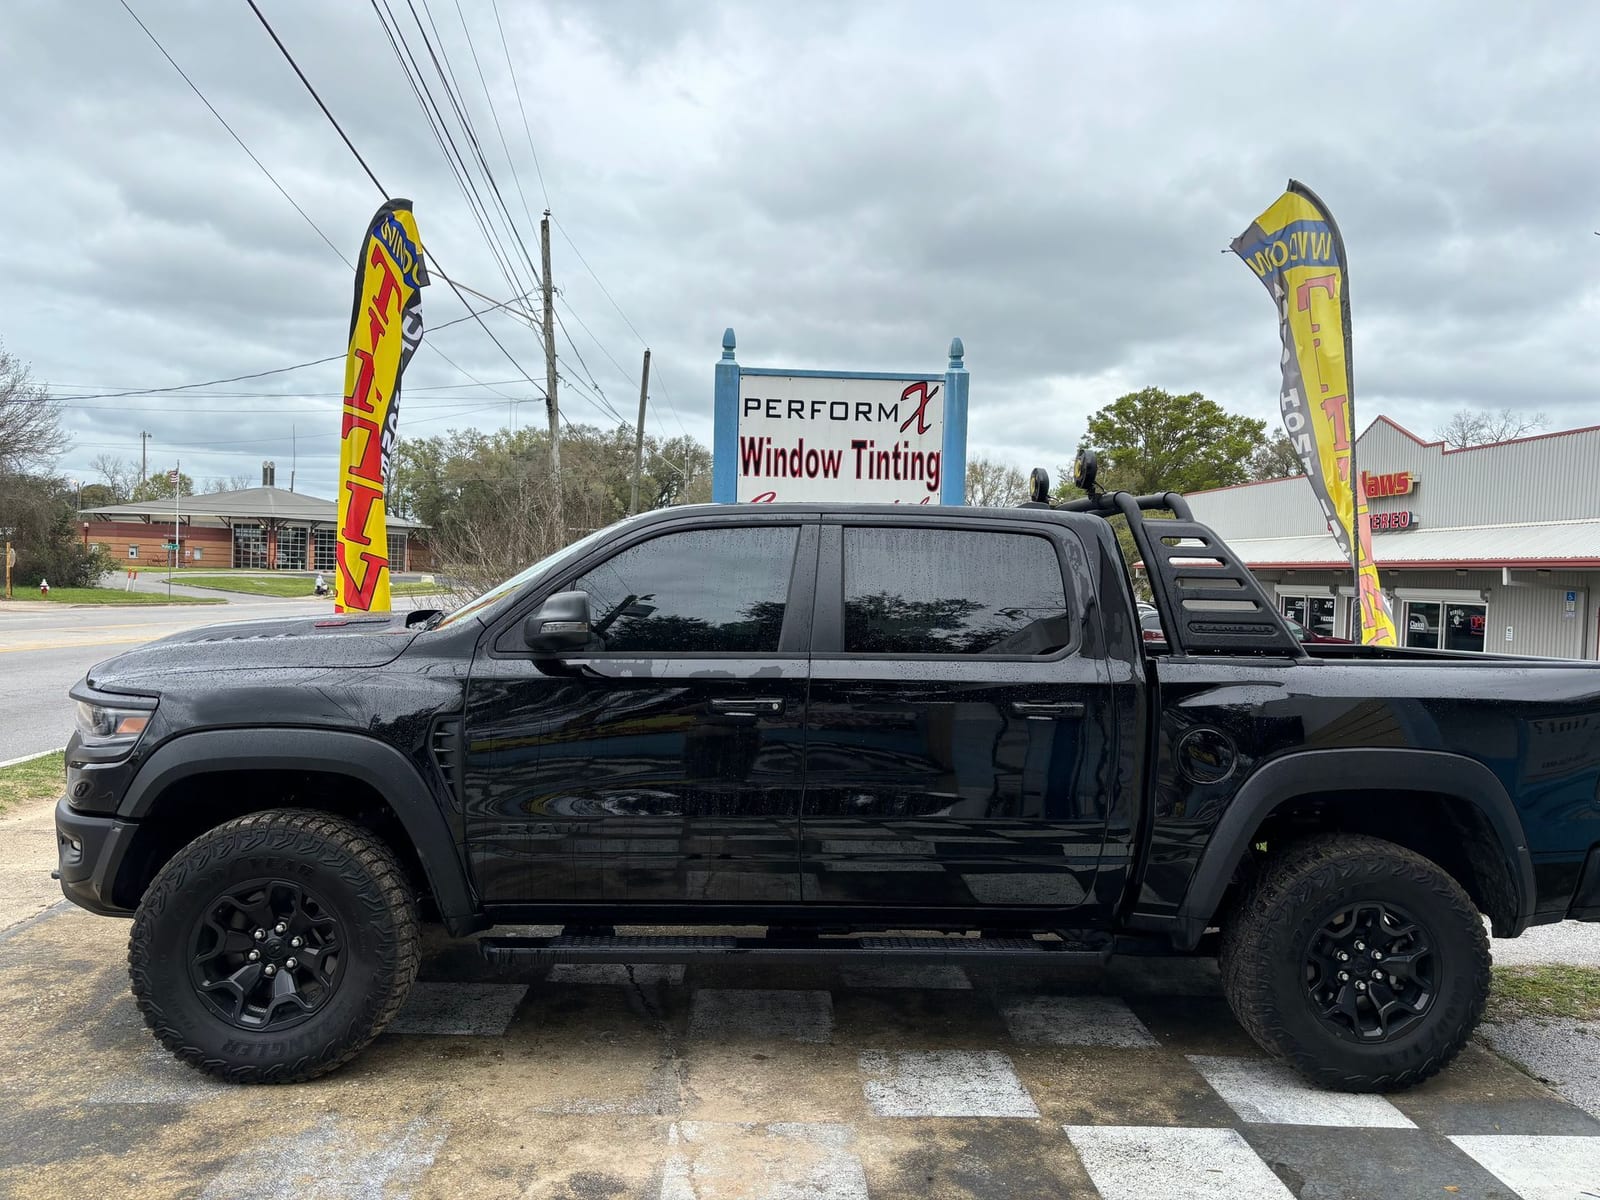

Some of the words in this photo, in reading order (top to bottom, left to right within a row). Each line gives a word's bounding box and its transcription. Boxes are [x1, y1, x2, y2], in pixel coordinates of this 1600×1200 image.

[740, 436, 843, 480] Window
[851, 439, 941, 492] Tinting
[1369, 511, 1410, 530] EREO
